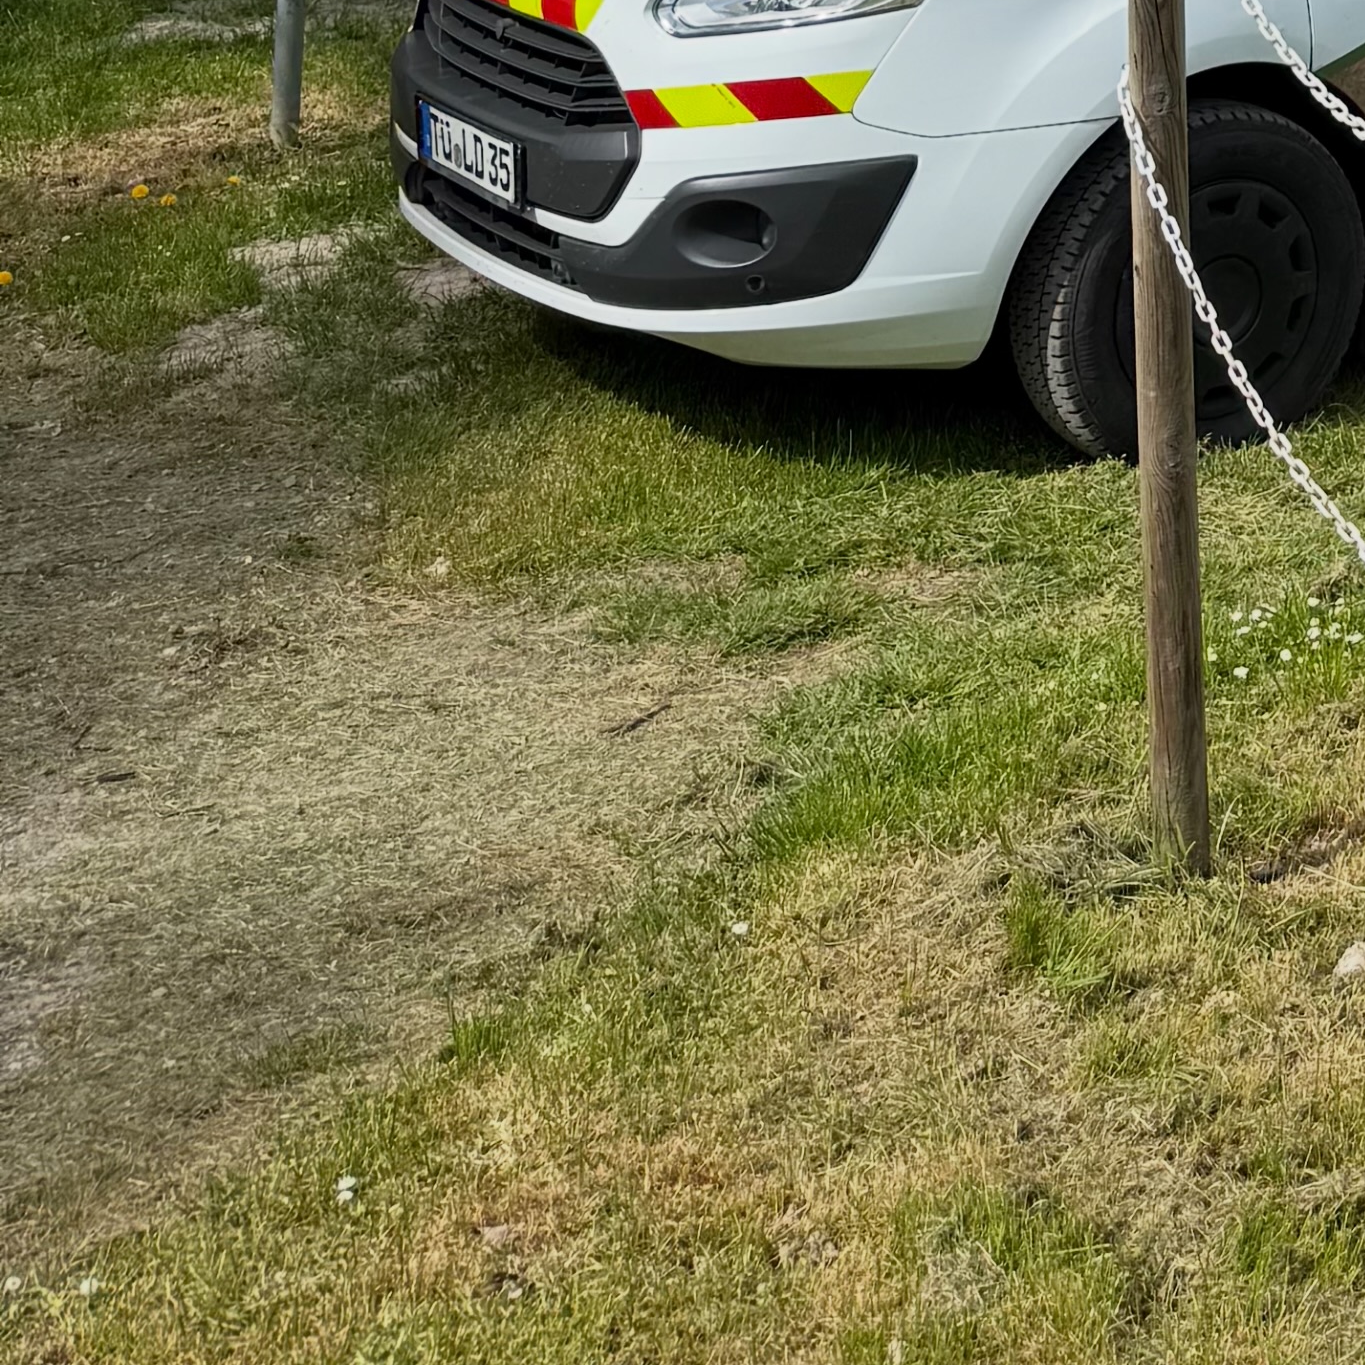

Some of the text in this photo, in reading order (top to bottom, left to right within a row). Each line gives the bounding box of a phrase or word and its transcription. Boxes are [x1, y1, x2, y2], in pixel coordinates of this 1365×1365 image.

[429, 112, 510, 192] TÜ LD 35
